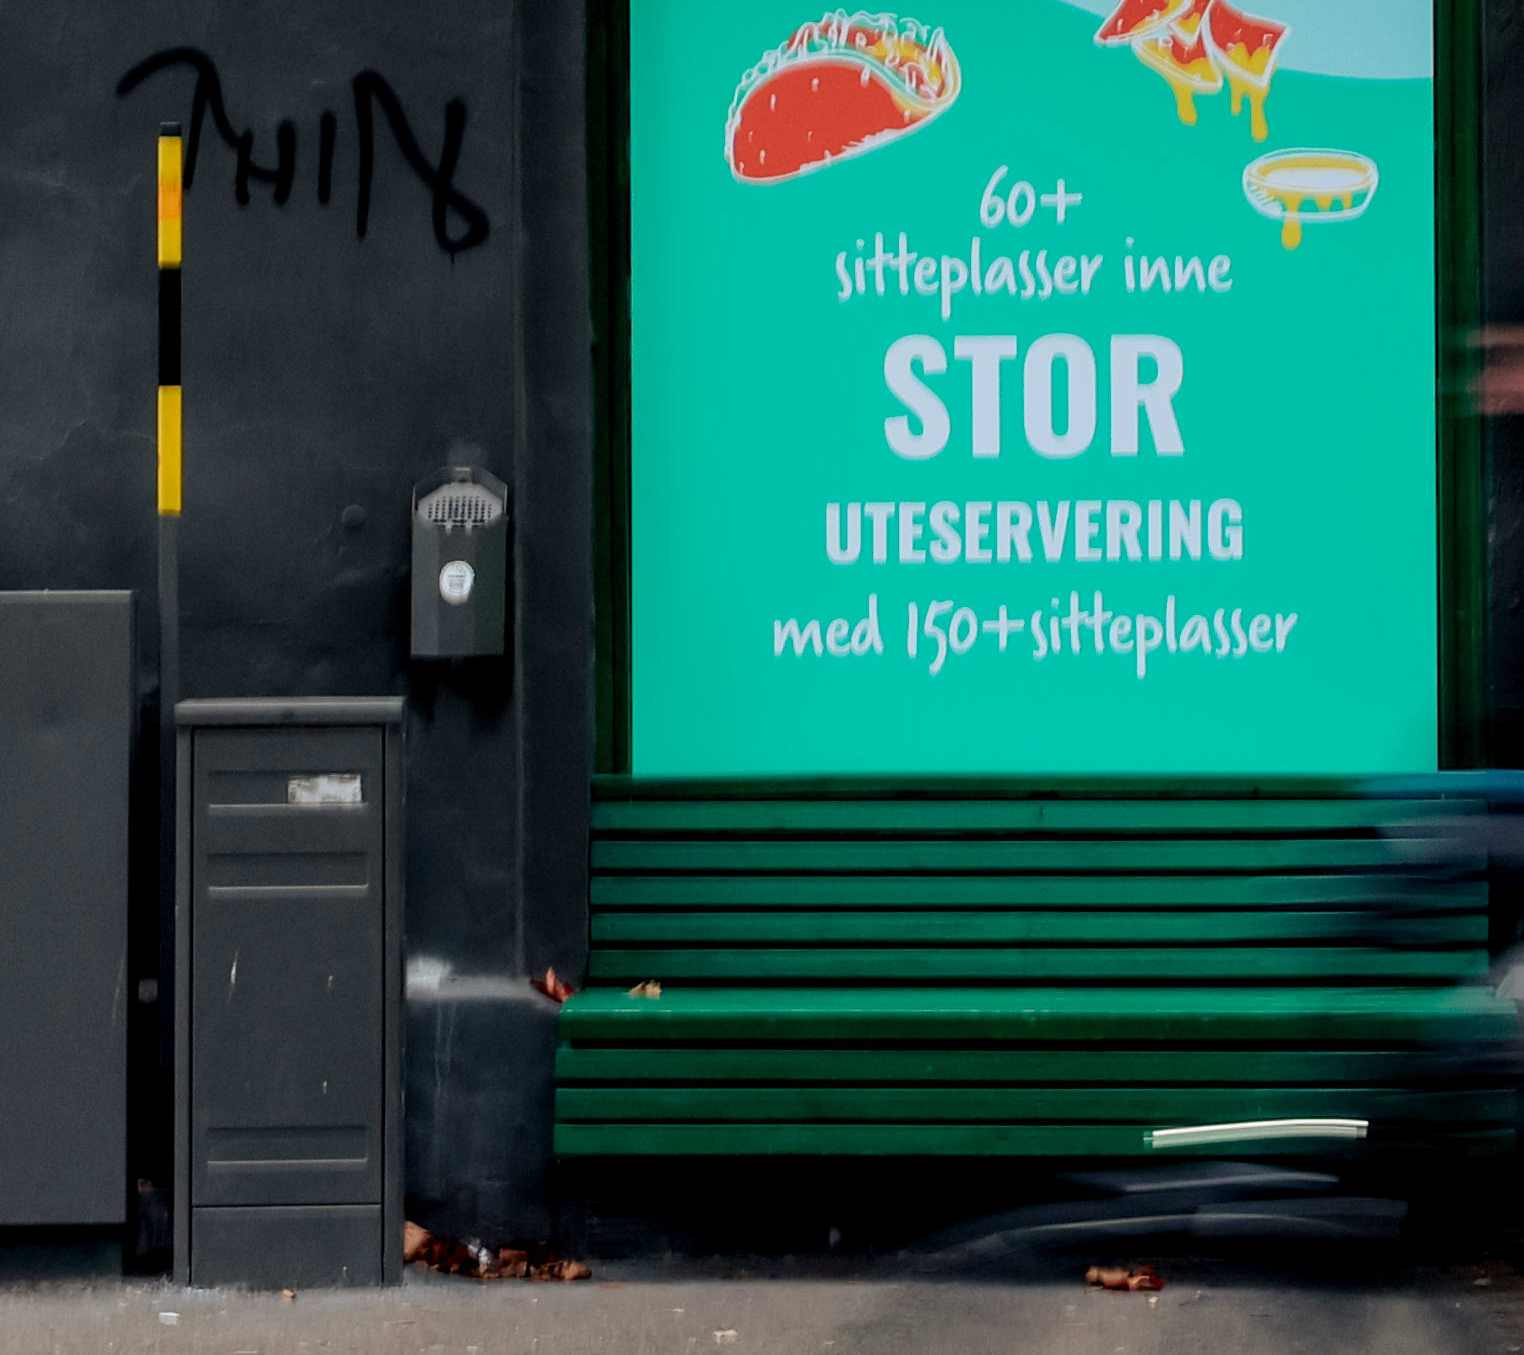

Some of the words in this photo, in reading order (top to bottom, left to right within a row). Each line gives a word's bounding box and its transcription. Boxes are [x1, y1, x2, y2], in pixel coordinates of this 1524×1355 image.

[979, 165, 1083, 227] 60+
[835, 232, 1103, 320] sitteplasser
[1124, 237, 1233, 292] inne
[883, 333, 1185, 459] STOR
[826, 498, 1243, 564] UTESERVERING
[773, 594, 884, 656] med
